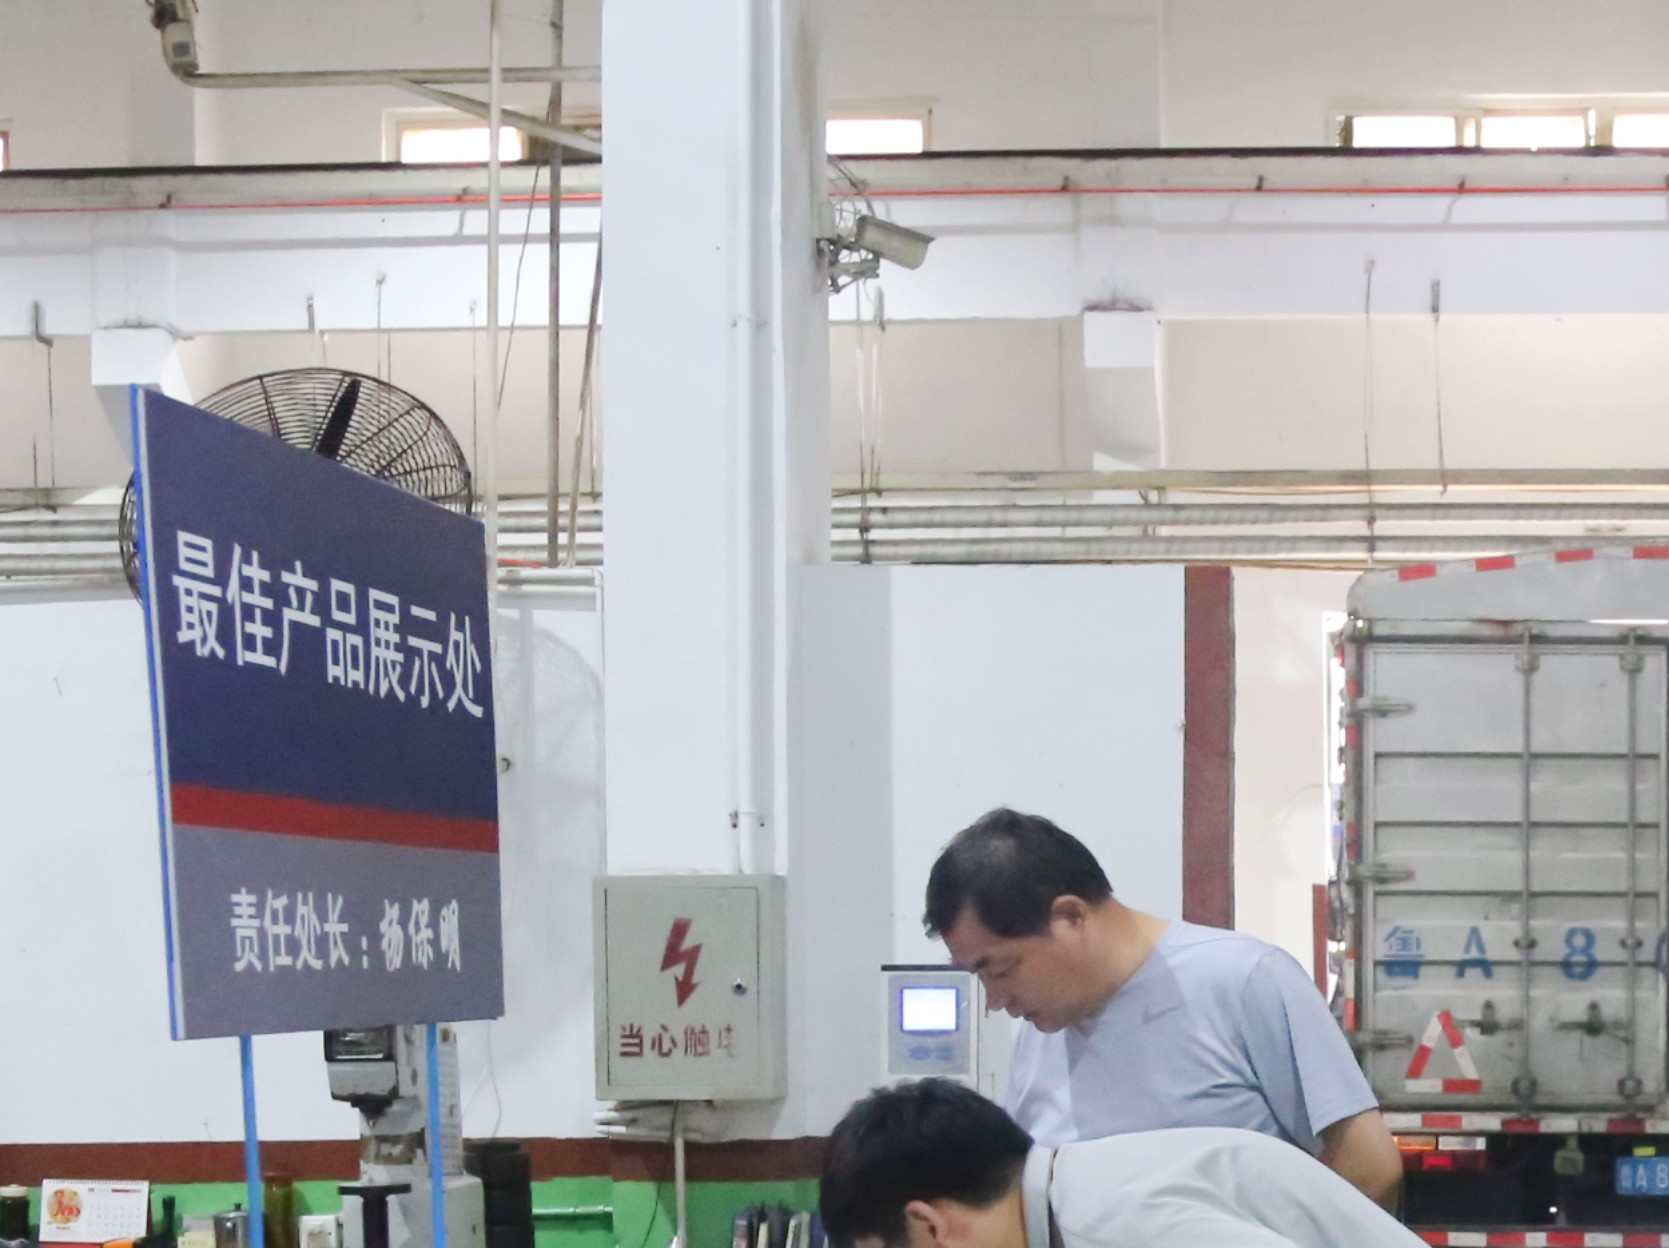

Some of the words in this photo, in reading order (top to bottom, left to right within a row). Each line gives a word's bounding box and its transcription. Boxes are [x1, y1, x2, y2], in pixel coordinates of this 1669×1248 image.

[171, 530, 485, 719] 最佳产品展示处
